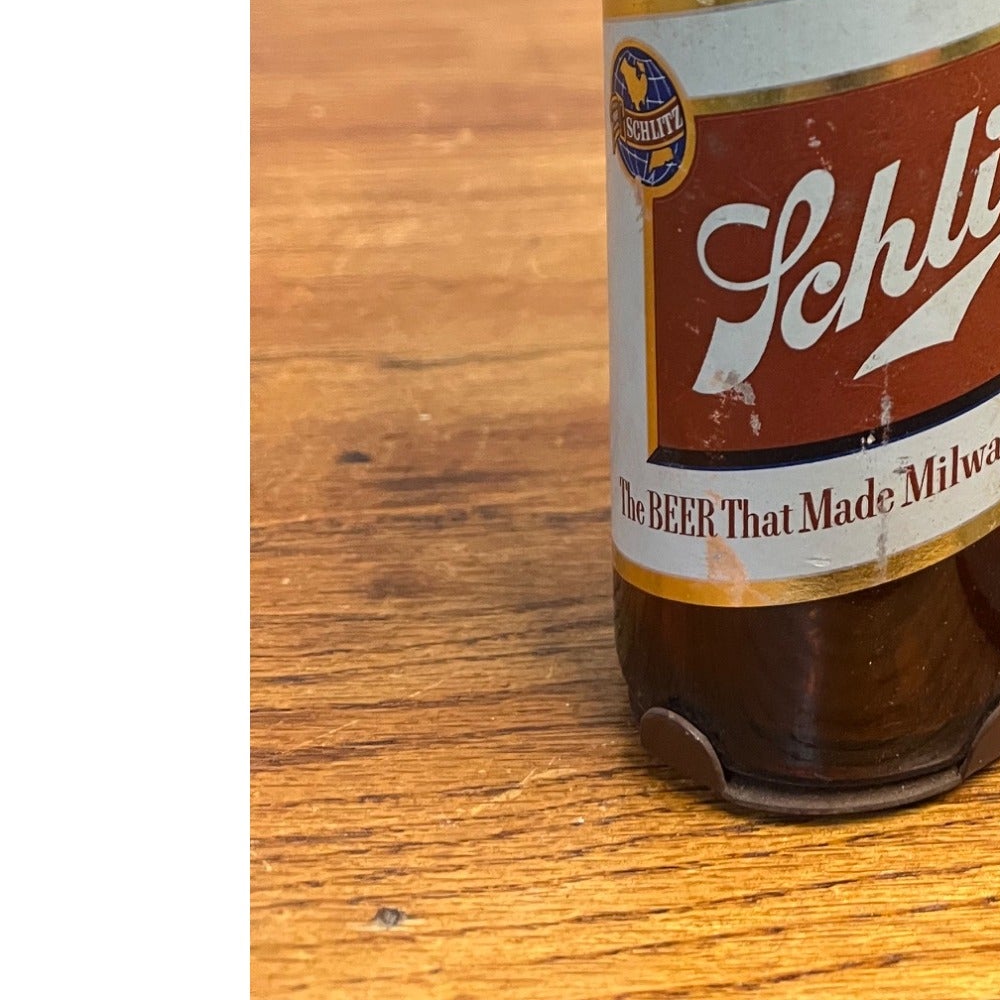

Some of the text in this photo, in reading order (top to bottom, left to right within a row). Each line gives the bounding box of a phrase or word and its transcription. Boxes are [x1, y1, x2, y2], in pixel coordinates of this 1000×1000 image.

[626, 104, 684, 141] SCHLITZ
[619, 476, 645, 525] The
[647, 489, 718, 538] BEER
[720, 498, 794, 539] That
[798, 477, 895, 533] Made
